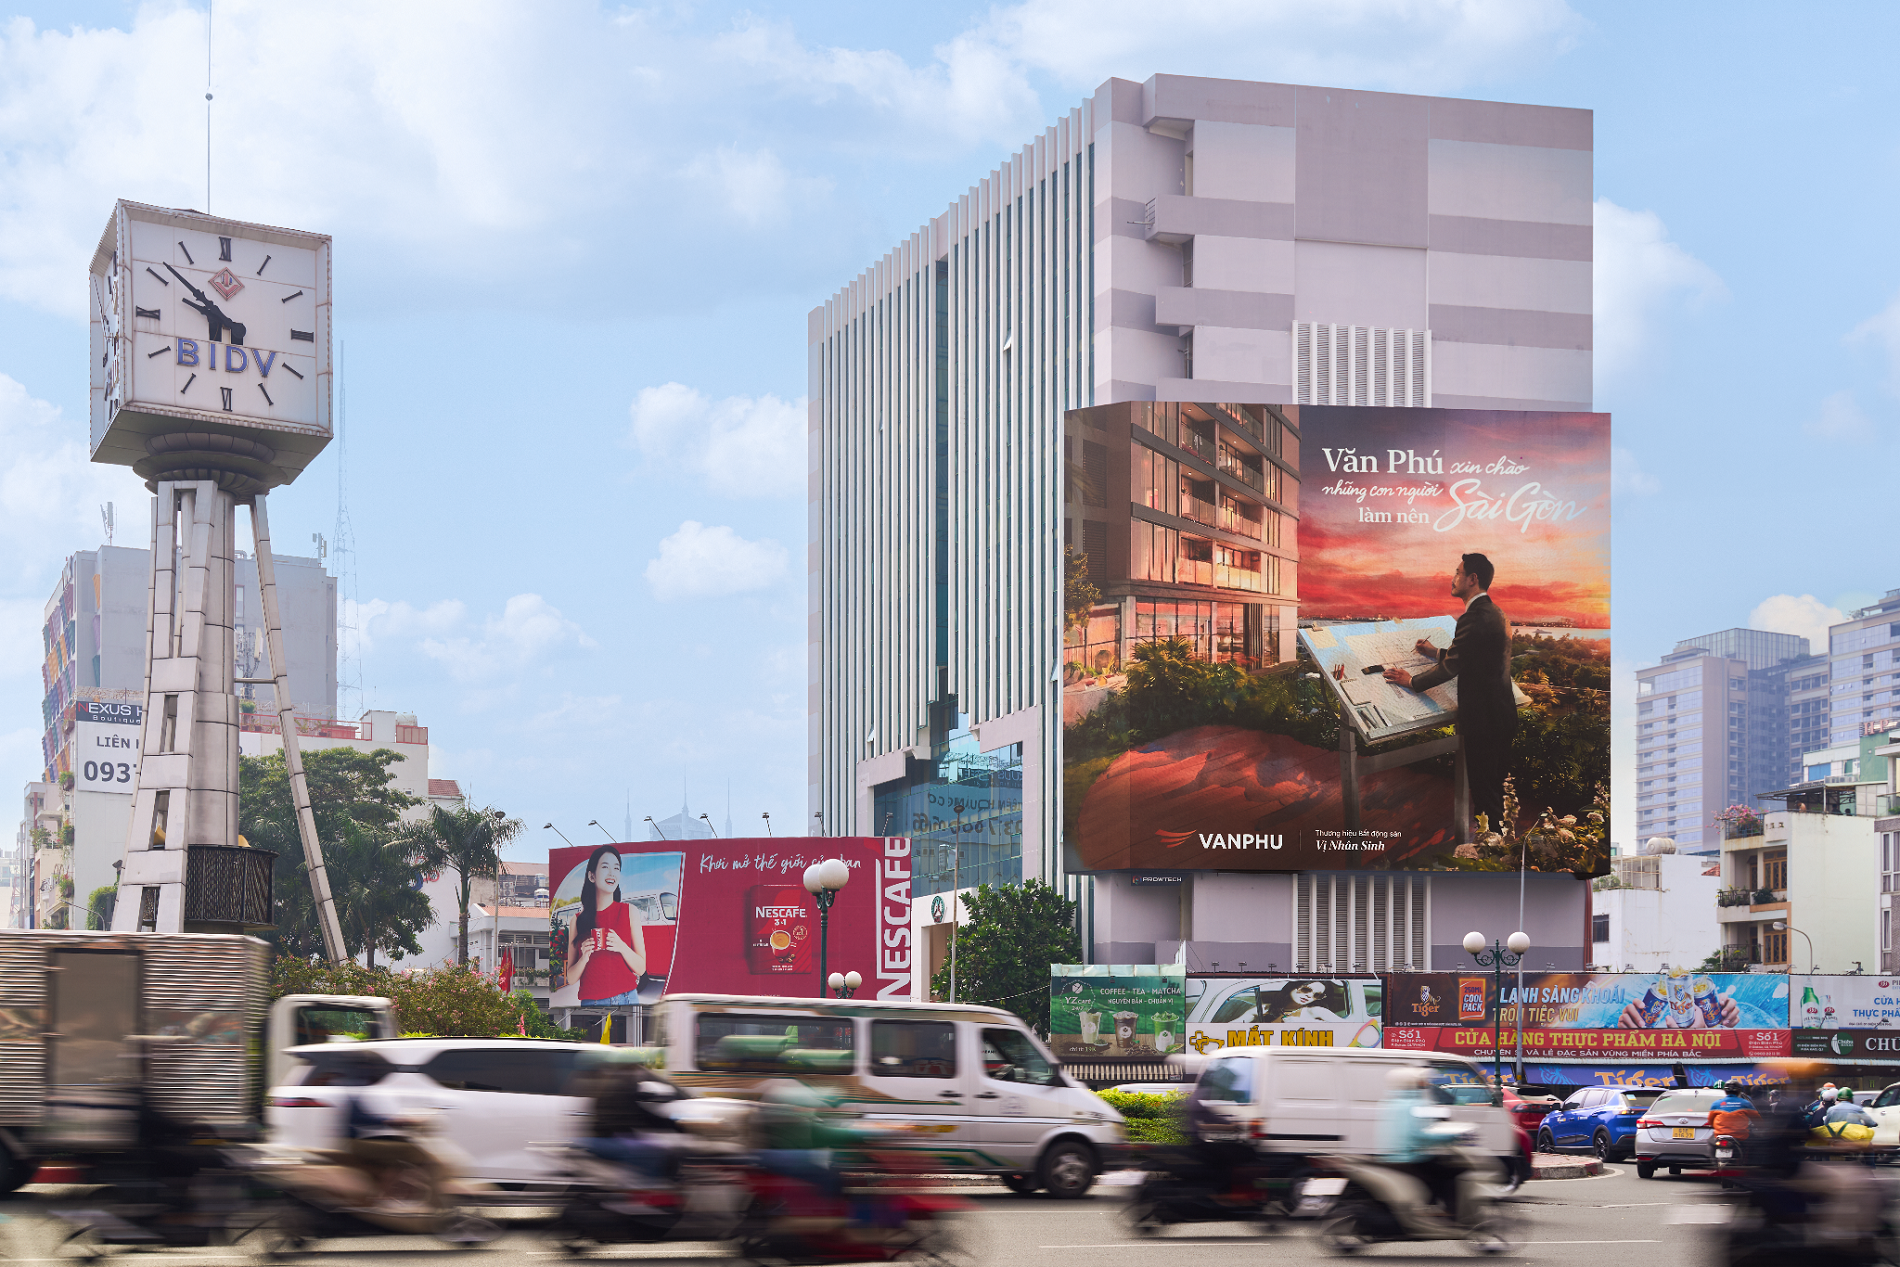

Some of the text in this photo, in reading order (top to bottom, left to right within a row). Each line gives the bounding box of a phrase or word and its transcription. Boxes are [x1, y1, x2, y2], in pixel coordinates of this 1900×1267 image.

[176, 337, 277, 378] BIDV
[1322, 447, 1530, 475] Văn Phú xin chào
[1321, 479, 1444, 505] những con người
[1432, 478, 1588, 534] Sài Gòn
[1358, 507, 1430, 524] làm nên
[78, 702, 132, 716] NEXUS
[96, 734, 130, 749] LIÊN
[83, 760, 137, 783] 093
[1199, 833, 1283, 850] VANPHU
[1316, 840, 1385, 852] Vị Nhân Sinh
[754, 853, 778, 872] thế
[780, 853, 807, 875] giới
[1100, 987, 1181, 995] COFFEE TEA MATCHA
[1463, 994, 1483, 1003] COOL
[1541, 985, 1580, 1004] SẢNG
[1581, 984, 1626, 1005] KHOÁI
[1462, 1003, 1483, 1012] PACK
[1874, 995, 1894, 1006] CỬA
[1411, 1002, 1440, 1017] Tiger
[1560, 1008, 1579, 1022] VUI
[1853, 1009, 1879, 1020] THỰC
[1281, 1027, 1334, 1047] KÍNH
[1399, 1029, 1422, 1039] Số 1
[1455, 1028, 1721, 1049] CỬA HÀNG THỰC PHẨM HÀ NỘI
[1756, 1032, 1778, 1041] Số 1
[1526, 1048, 1540, 1056] VÀ
[1602, 1049, 1628, 1057] VÙNG
[1632, 1048, 1654, 1057] MIỀN
[1682, 1049, 1702, 1057] BẮC
